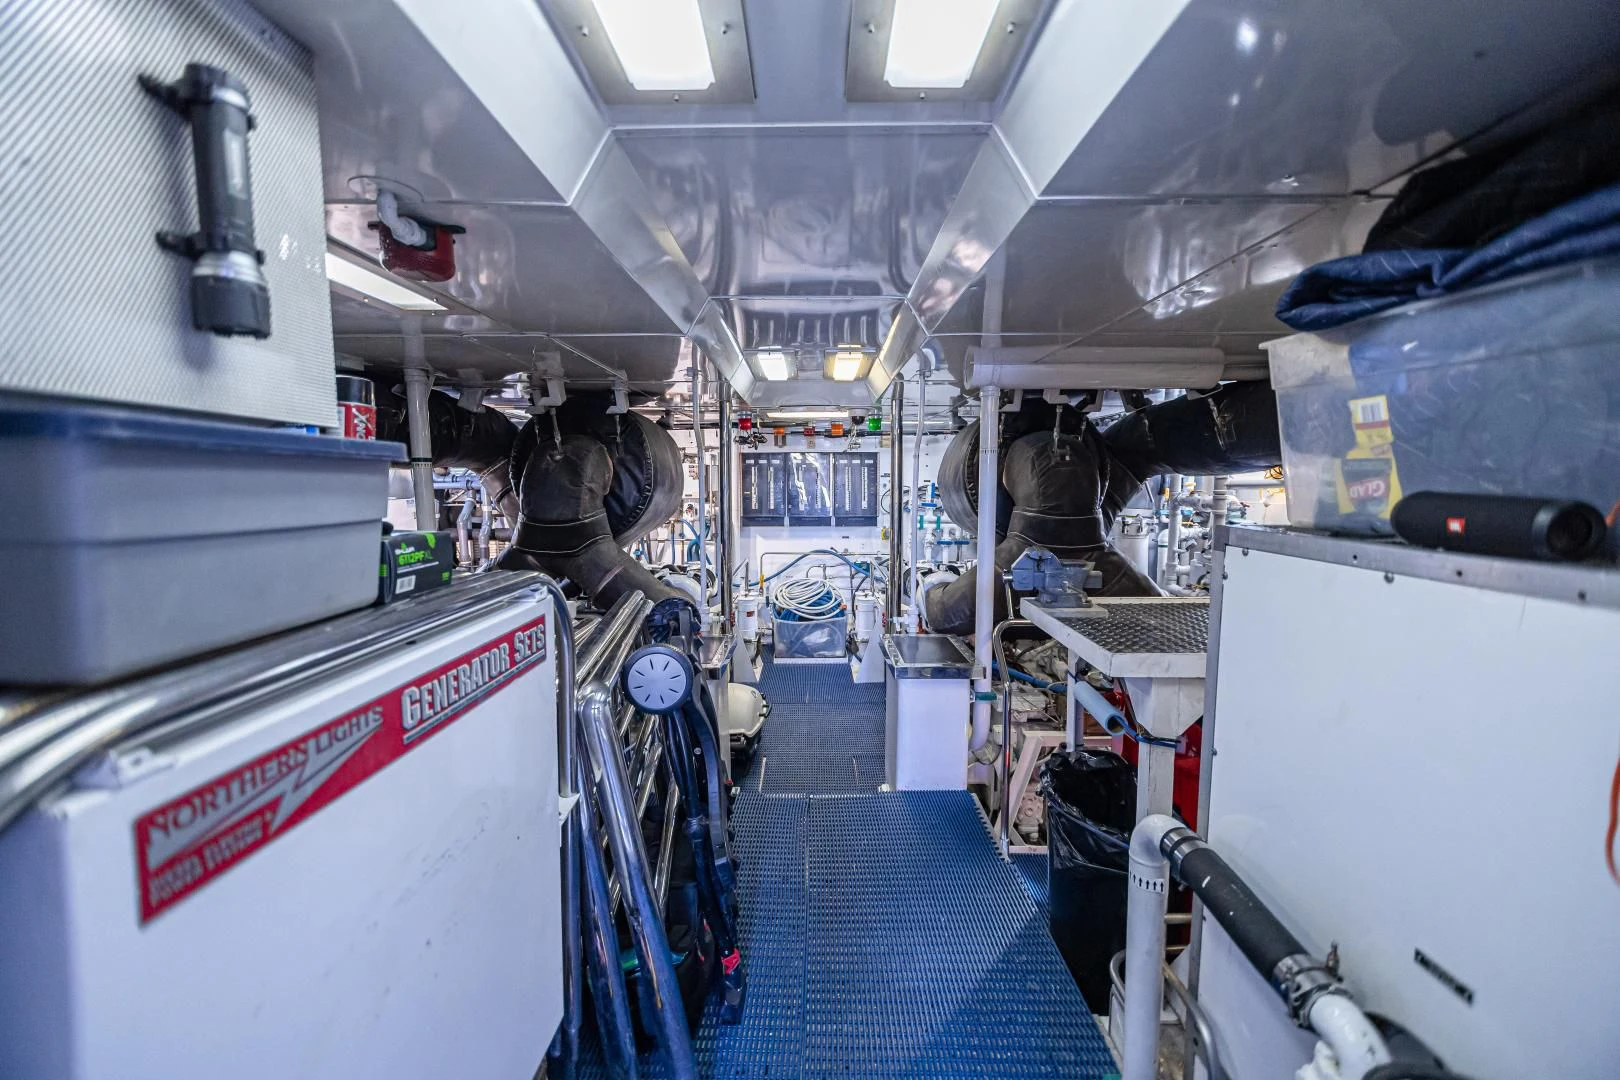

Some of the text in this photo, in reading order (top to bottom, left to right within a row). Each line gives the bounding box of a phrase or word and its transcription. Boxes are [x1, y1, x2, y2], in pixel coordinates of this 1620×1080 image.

[1349, 480, 1386, 498] GLAD
[401, 624, 545, 730] GENERATOR SETS
[147, 705, 383, 847] NORTHERN LIGHTS
